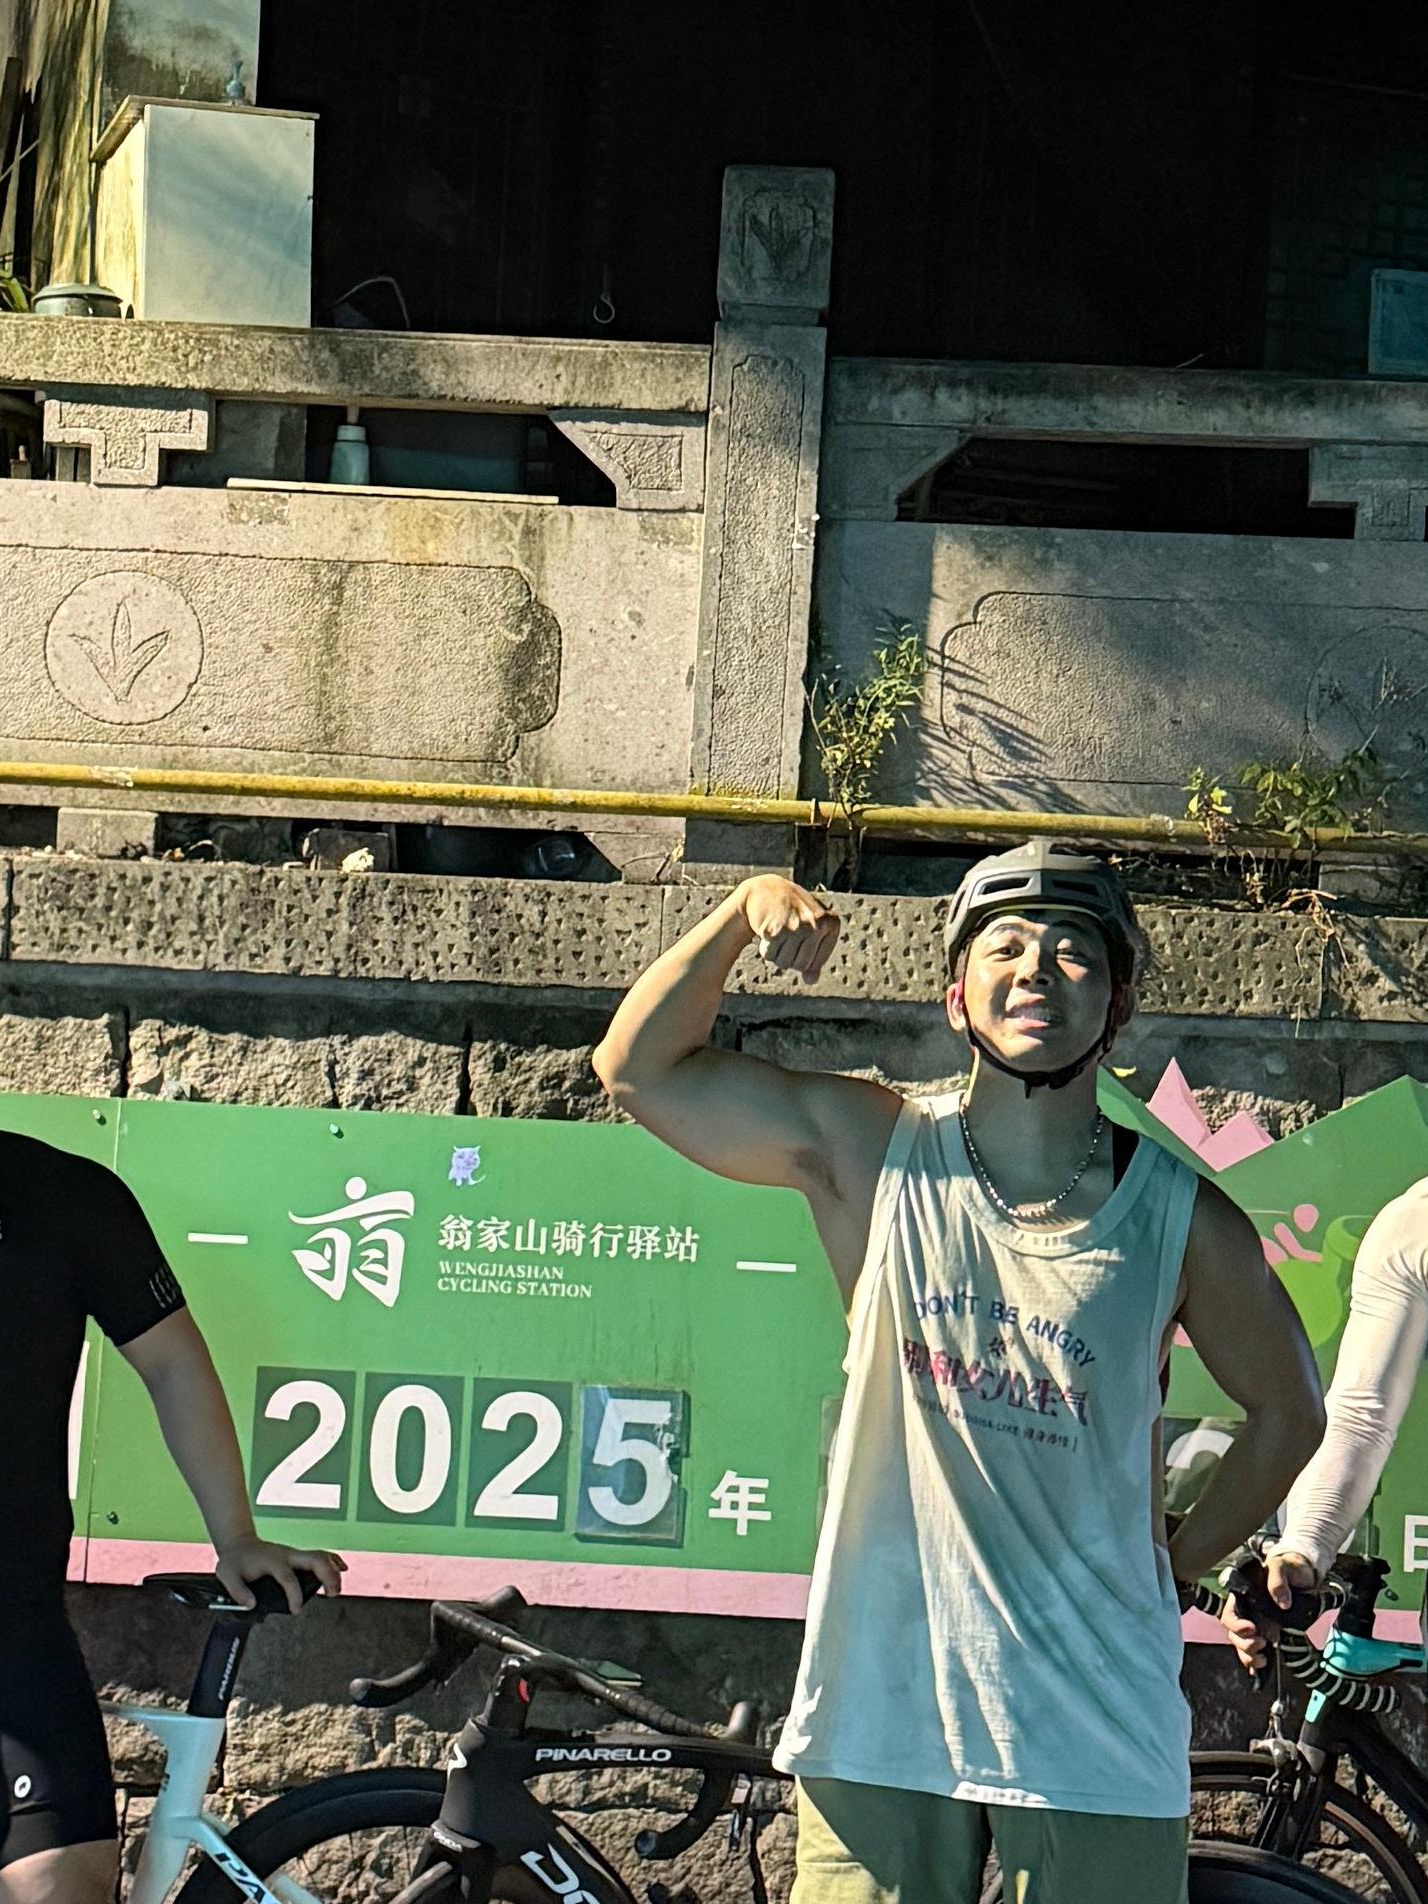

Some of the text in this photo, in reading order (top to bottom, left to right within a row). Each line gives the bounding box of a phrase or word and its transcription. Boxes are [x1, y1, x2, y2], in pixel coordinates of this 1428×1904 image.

[437, 1213, 700, 1264] 翁家山骑行驿站
[436, 1277, 593, 1300] CYCLING STATION
[438, 1260, 565, 1281] WENGJIASHAN
[990, 1300, 1019, 1325] BE
[1025, 1315, 1096, 1367] ANGRY
[255, 1379, 772, 1537] 2025 年
[535, 1746, 672, 1764] PINARELLO
